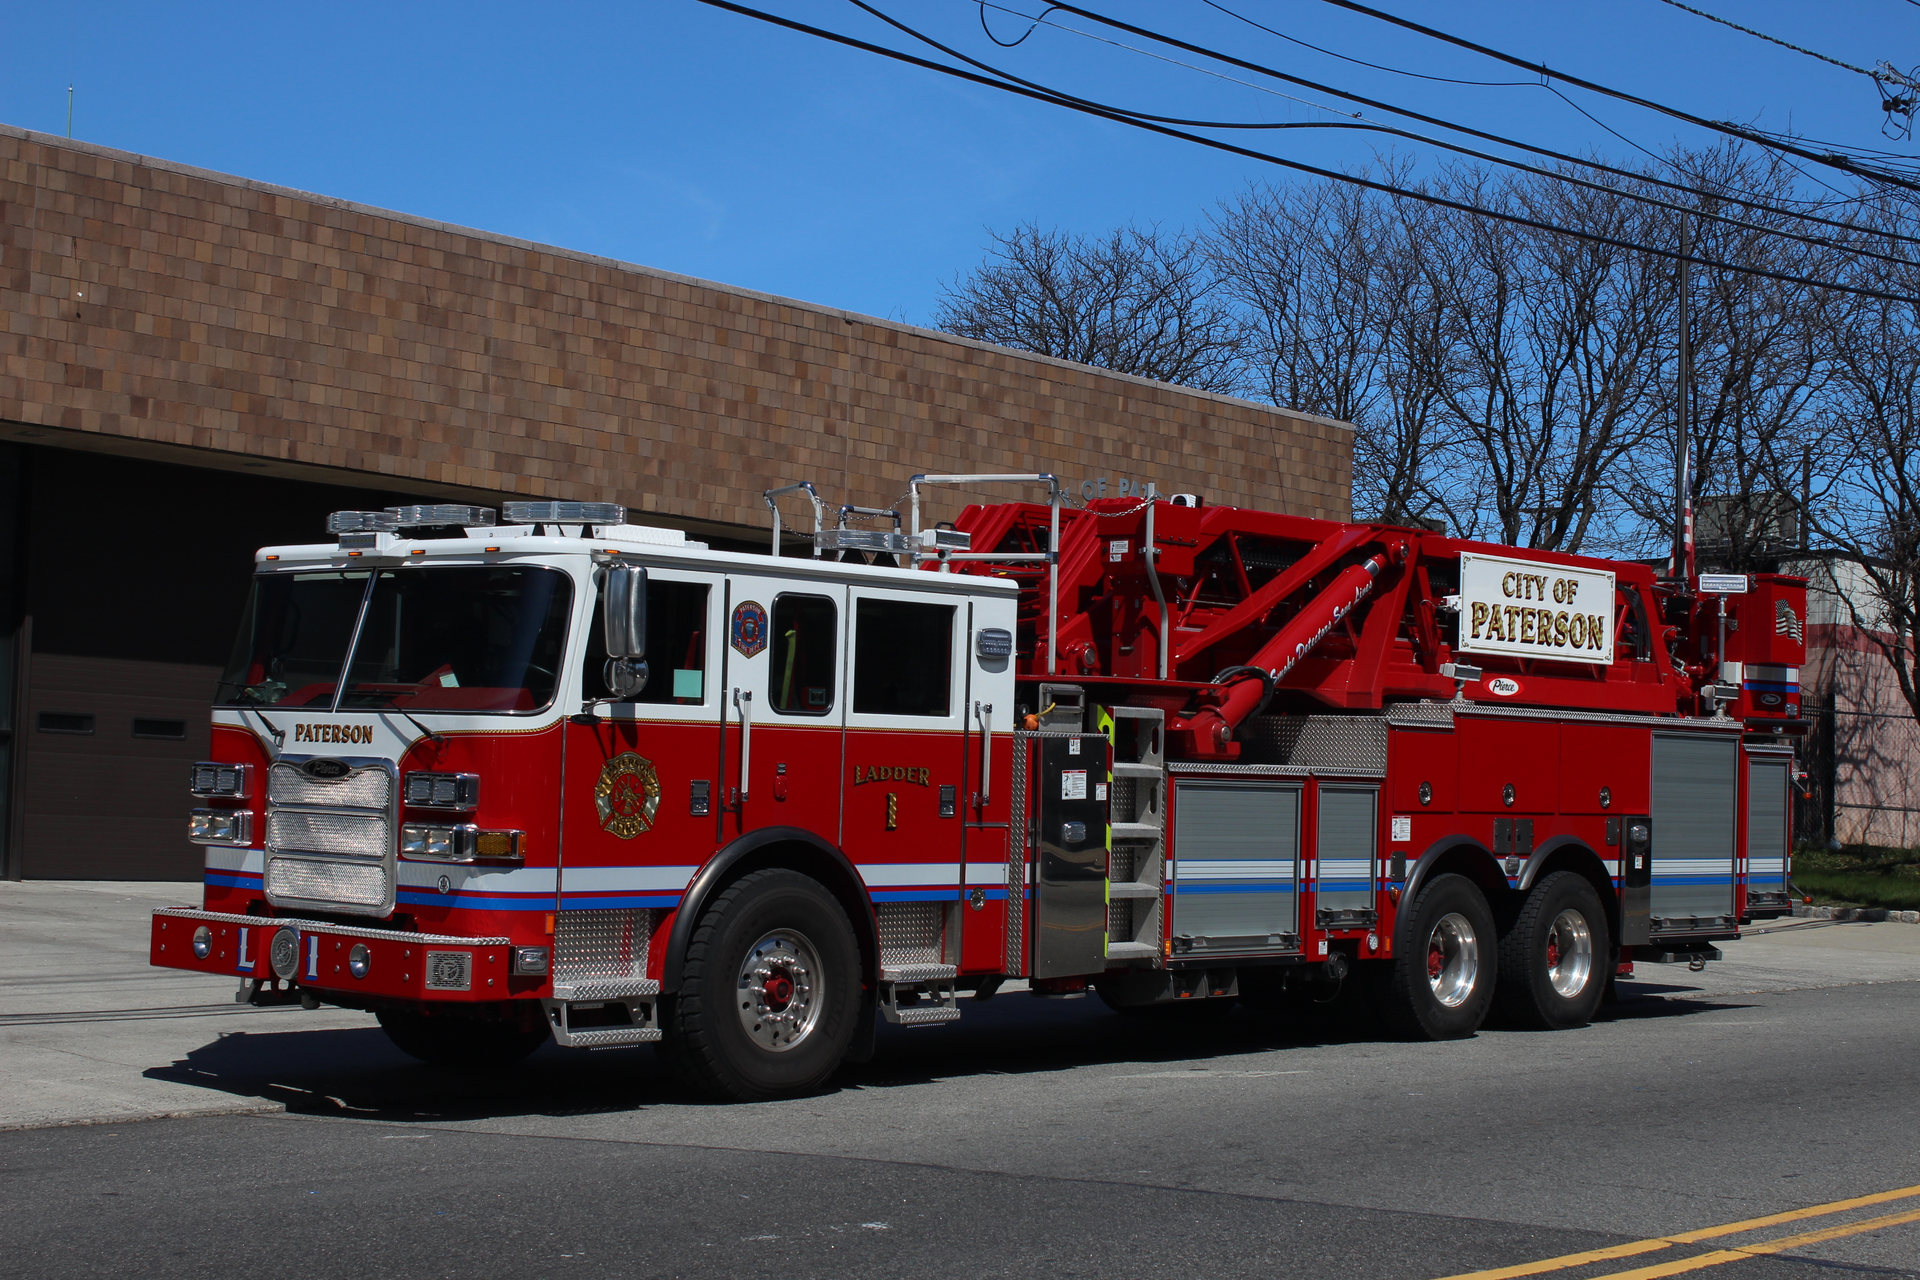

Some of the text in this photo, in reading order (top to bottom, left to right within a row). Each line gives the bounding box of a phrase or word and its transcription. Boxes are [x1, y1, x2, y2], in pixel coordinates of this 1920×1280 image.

[1082, 478, 1106, 501] OF
[1502, 571, 1578, 604] CITY OF
[1270, 580, 1372, 685] Smoke Detectors Save Lives
[1471, 602, 1605, 650] PATERSON
[1492, 679, 1515, 692] Pierce
[295, 724, 374, 744] PATERSON
[313, 762, 341, 775] Pierce
[606, 758, 651, 777] PATERSON
[854, 765, 931, 788] LADDER
[615, 820, 641, 834] FIRE
[236, 927, 256, 973] L
